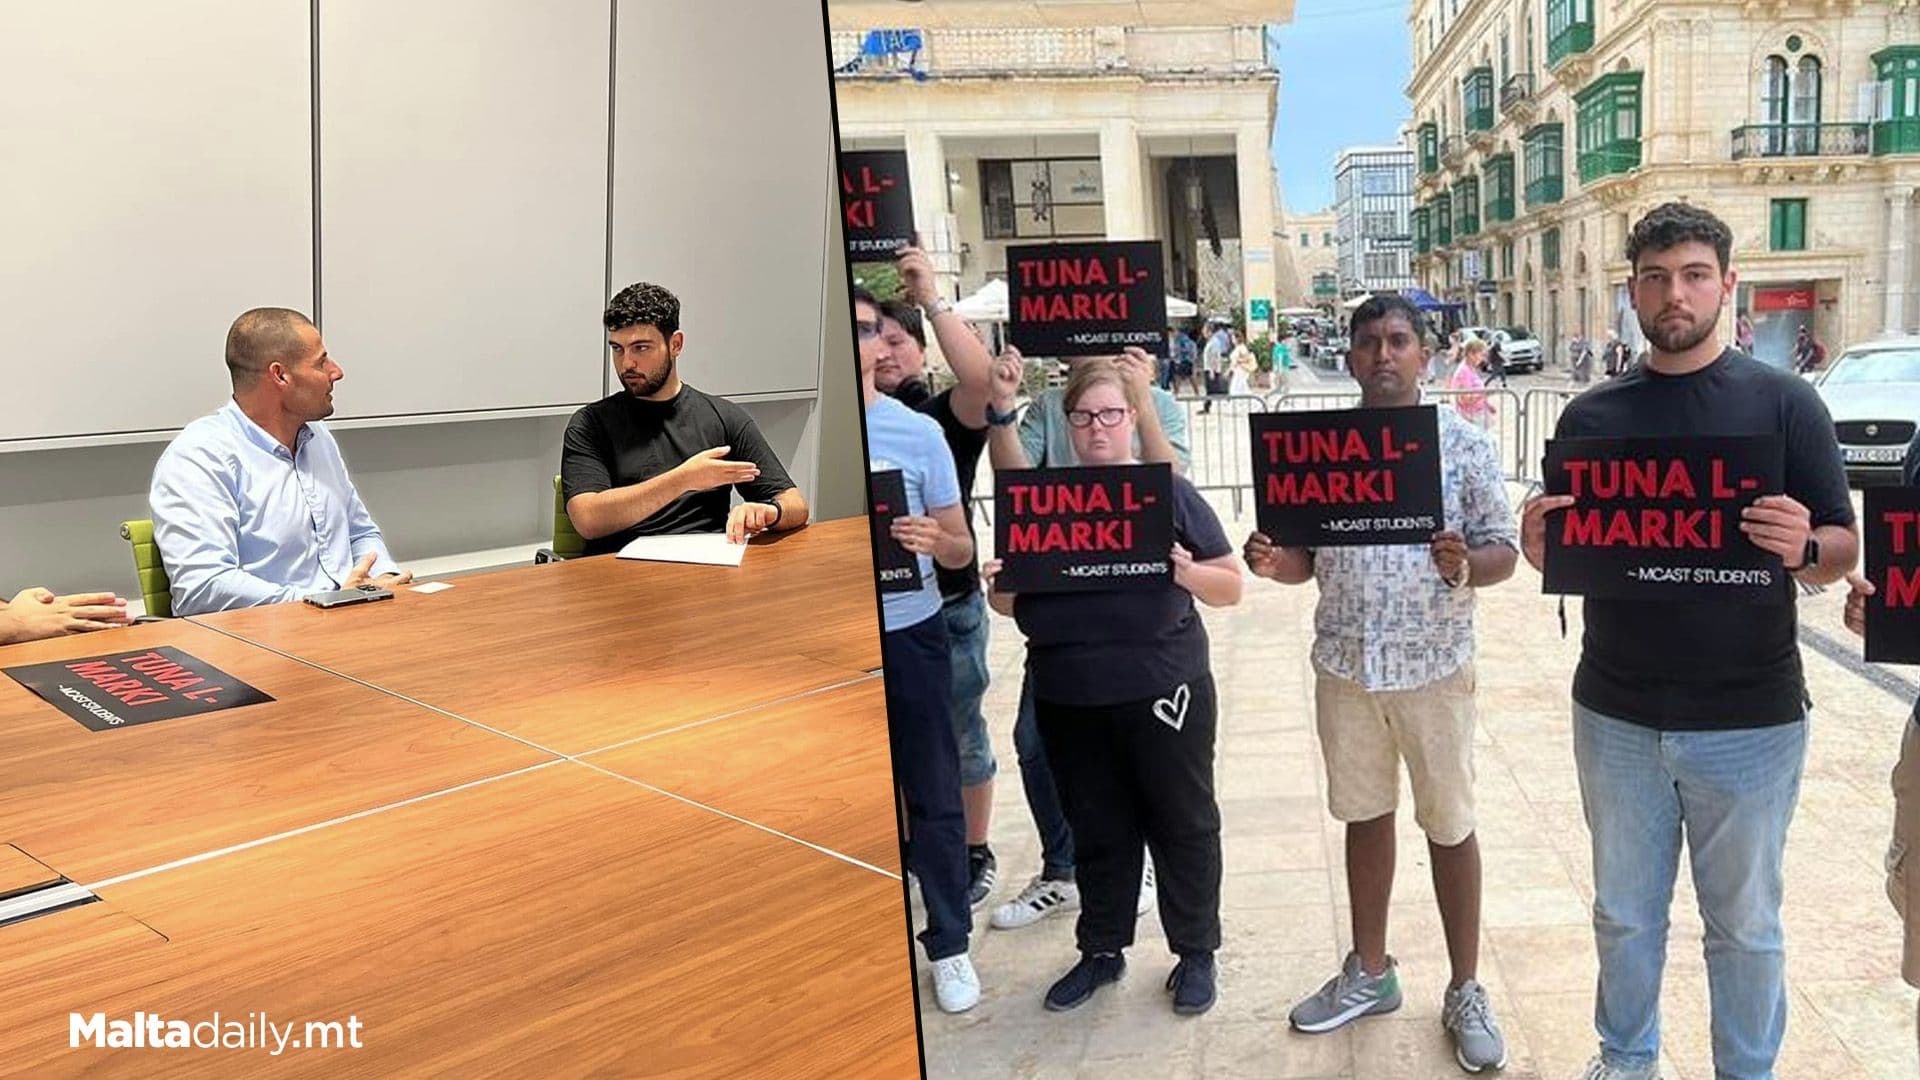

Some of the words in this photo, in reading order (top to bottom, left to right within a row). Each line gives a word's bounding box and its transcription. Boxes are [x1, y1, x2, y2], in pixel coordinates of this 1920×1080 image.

[1018, 258, 1109, 287] TUNA
[1118, 257, 1148, 285] L-
[1019, 292, 1129, 321] MARKI
[1111, 331, 1162, 344] STUDENTS
[1263, 428, 1371, 464] TUNA
[1382, 426, 1419, 460] L-
[1266, 469, 1395, 504] MARKI
[1563, 459, 1697, 498] TUNA
[1712, 459, 1758, 498] L-
[1008, 483, 1113, 516] TUNA
[1122, 482, 1157, 512] L-
[1008, 519, 1133, 552] MARKI
[1373, 516, 1436, 531] STUDENTS
[1562, 508, 1724, 548] MARKI
[1112, 562, 1168, 576] STUDENTS
[1638, 567, 1692, 583] MCAST
[1693, 568, 1772, 586] STUDENTS
[65, 661, 170, 706] MARKI
[121, 652, 206, 691] TUNA
